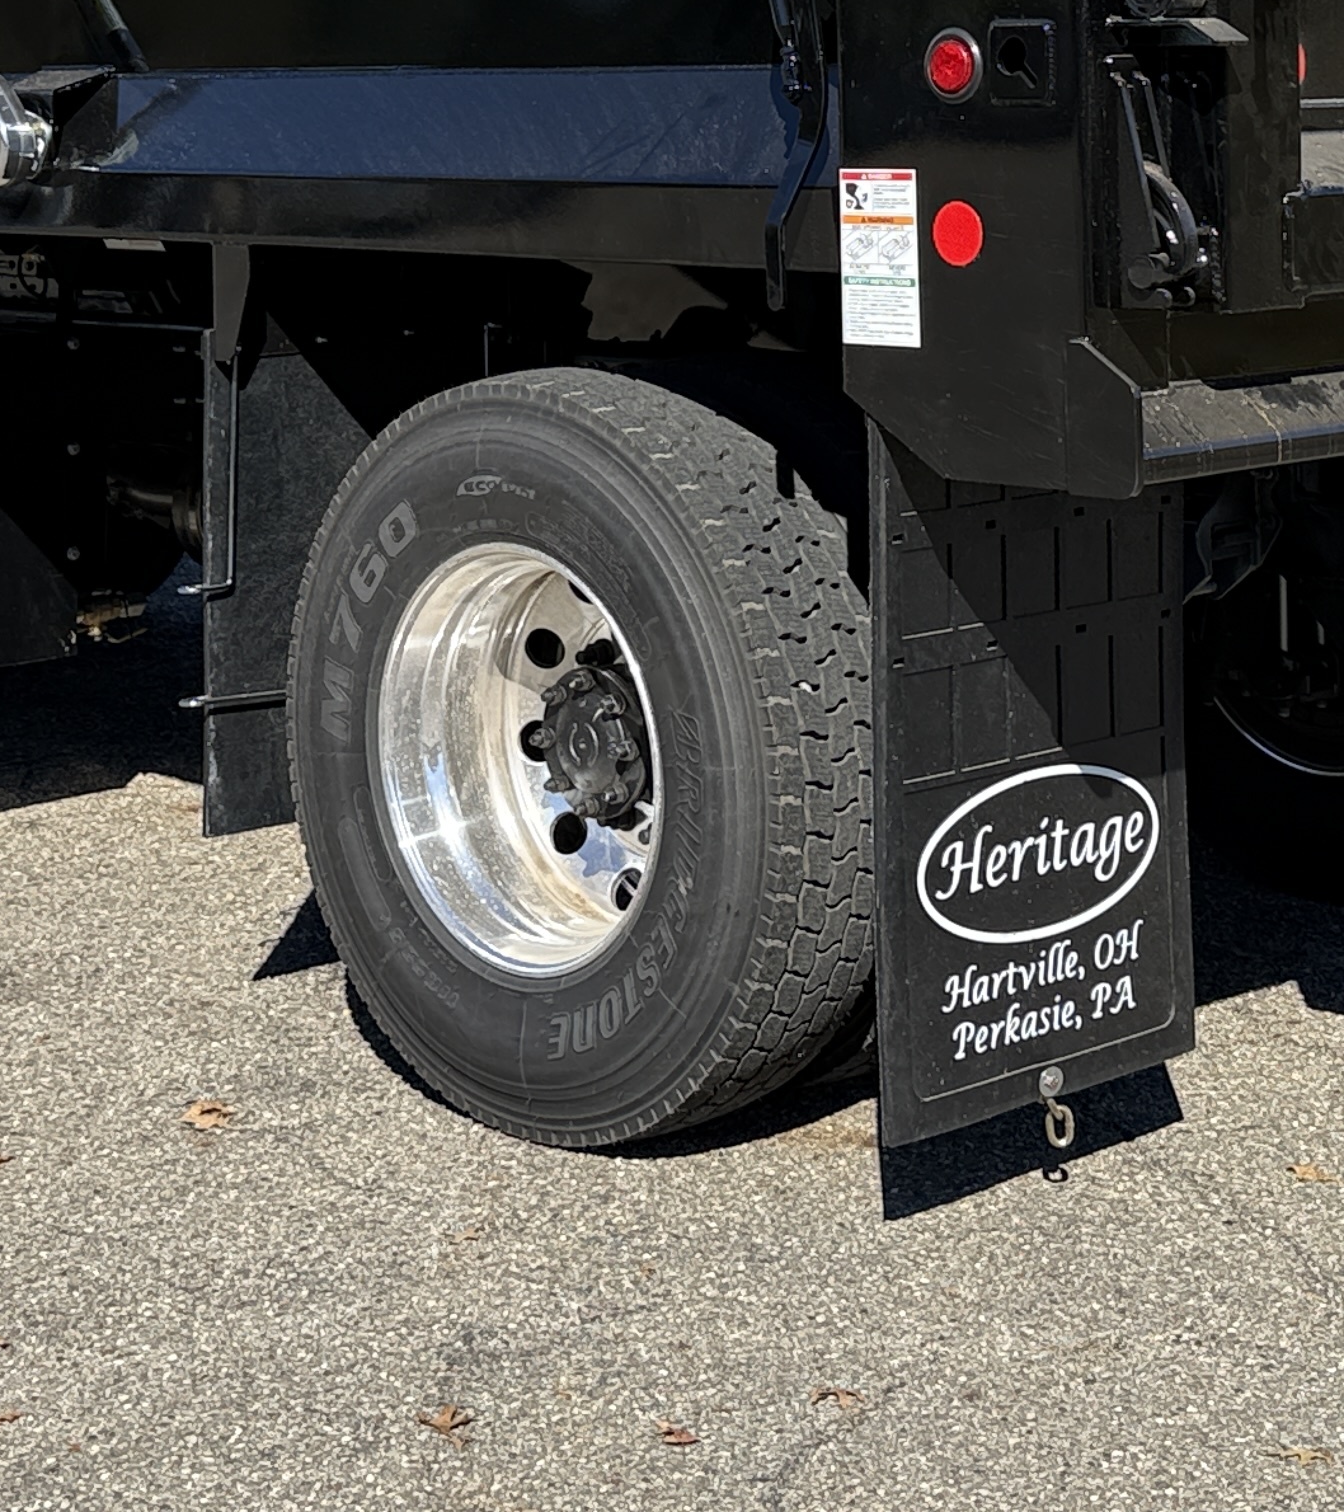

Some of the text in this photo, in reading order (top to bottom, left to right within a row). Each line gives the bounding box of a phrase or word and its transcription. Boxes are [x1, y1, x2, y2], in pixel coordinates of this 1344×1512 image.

[935, 811, 1144, 900] Heritage
[941, 919, 1144, 1013] Hartville, OH
[953, 975, 1138, 1060] Perkasie, PA
